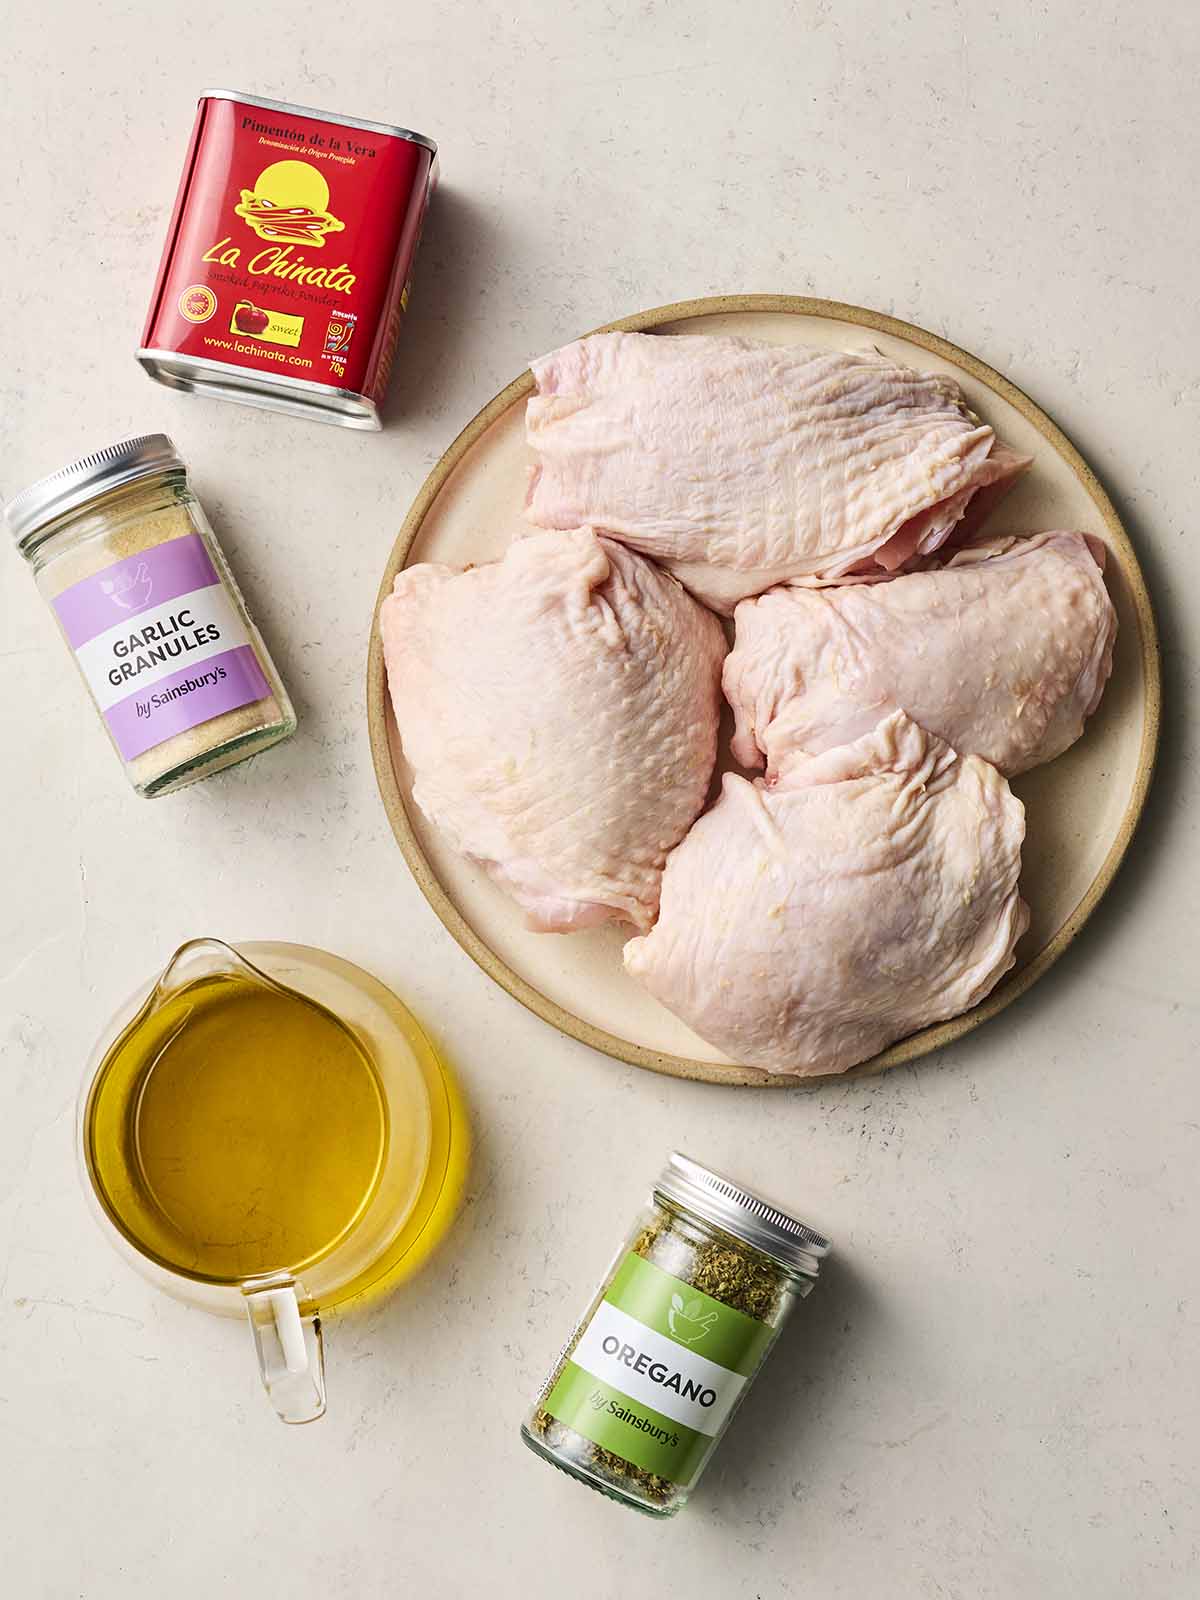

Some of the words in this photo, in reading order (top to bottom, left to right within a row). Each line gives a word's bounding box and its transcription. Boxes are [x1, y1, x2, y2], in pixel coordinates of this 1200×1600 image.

[242, 117, 305, 143] Pimentón
[309, 133, 325, 147] de
[329, 137, 341, 151] la
[346, 141, 376, 158] Vera
[308, 147, 329, 160] Origen
[201, 237, 241, 269] La
[247, 245, 357, 295] Chinata
[203, 336, 313, 369] www.lachinata.com
[270, 323, 299, 337] sweet
[329, 361, 345, 377] 70g
[107, 623, 221, 687] GRANULES
[112, 608, 196, 660] GARLIC
[135, 701, 152, 719] by
[151, 666, 227, 709] Sainsbury's
[601, 1335, 718, 1409] OREGANO
[588, 1389, 607, 1411] by
[606, 1400, 680, 1448] Sainsbury's
